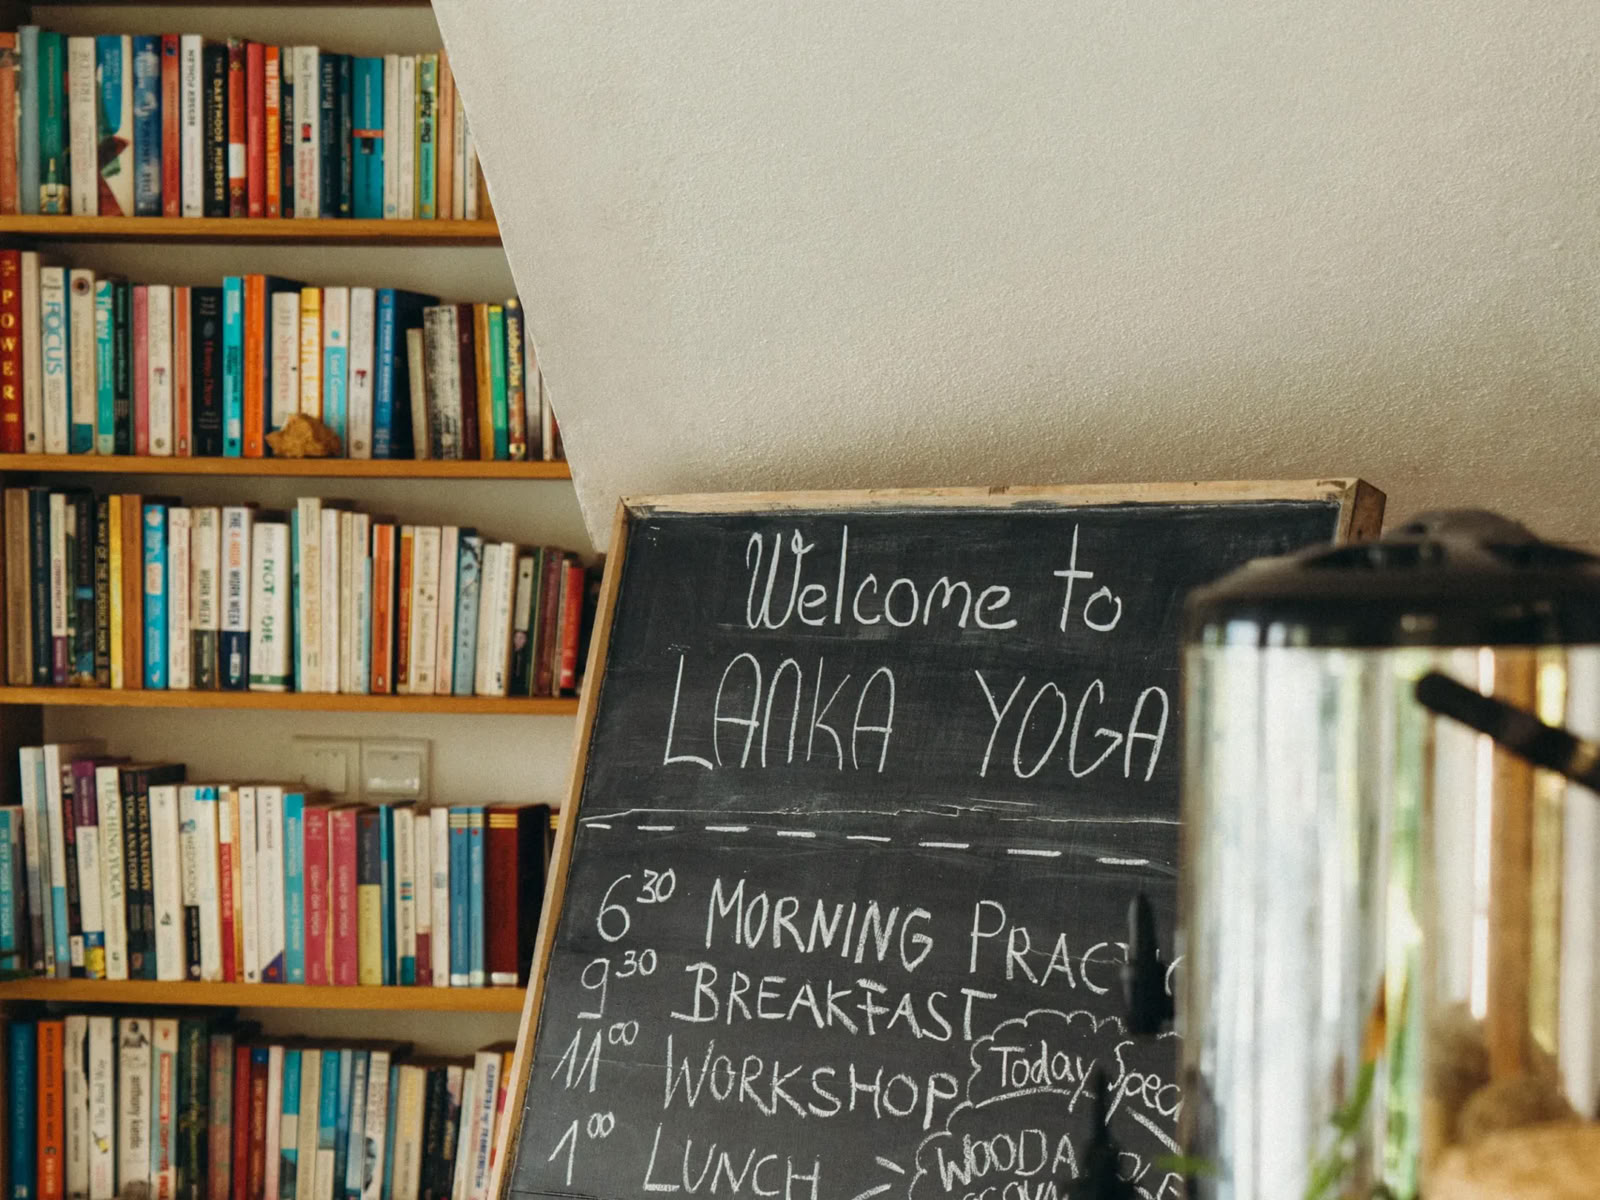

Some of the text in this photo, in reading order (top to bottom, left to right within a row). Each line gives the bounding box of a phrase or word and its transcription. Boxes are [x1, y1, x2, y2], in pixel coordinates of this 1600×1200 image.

[213, 78, 224, 143] DARTMOOR
[1, 289, 16, 401] POWER
[44, 301, 64, 375] FOCUS
[229, 570, 241, 598] WORK
[229, 600, 241, 626] WEEK
[262, 558, 275, 596] NOT
[745, 523, 1123, 632] Welcome to
[663, 652, 1170, 782] LANKA YOGA
[104, 780, 122, 899] TEACHING YOGA
[126, 795, 139, 891] YOGA ANATOMY
[137, 795, 151, 891] YOGA ANATOMY
[705, 877, 933, 972] MORNING
[670, 962, 997, 1041] BREAKFAST
[664, 1034, 958, 1130] WORKSHOP
[988, 1039, 1097, 1113] Today
